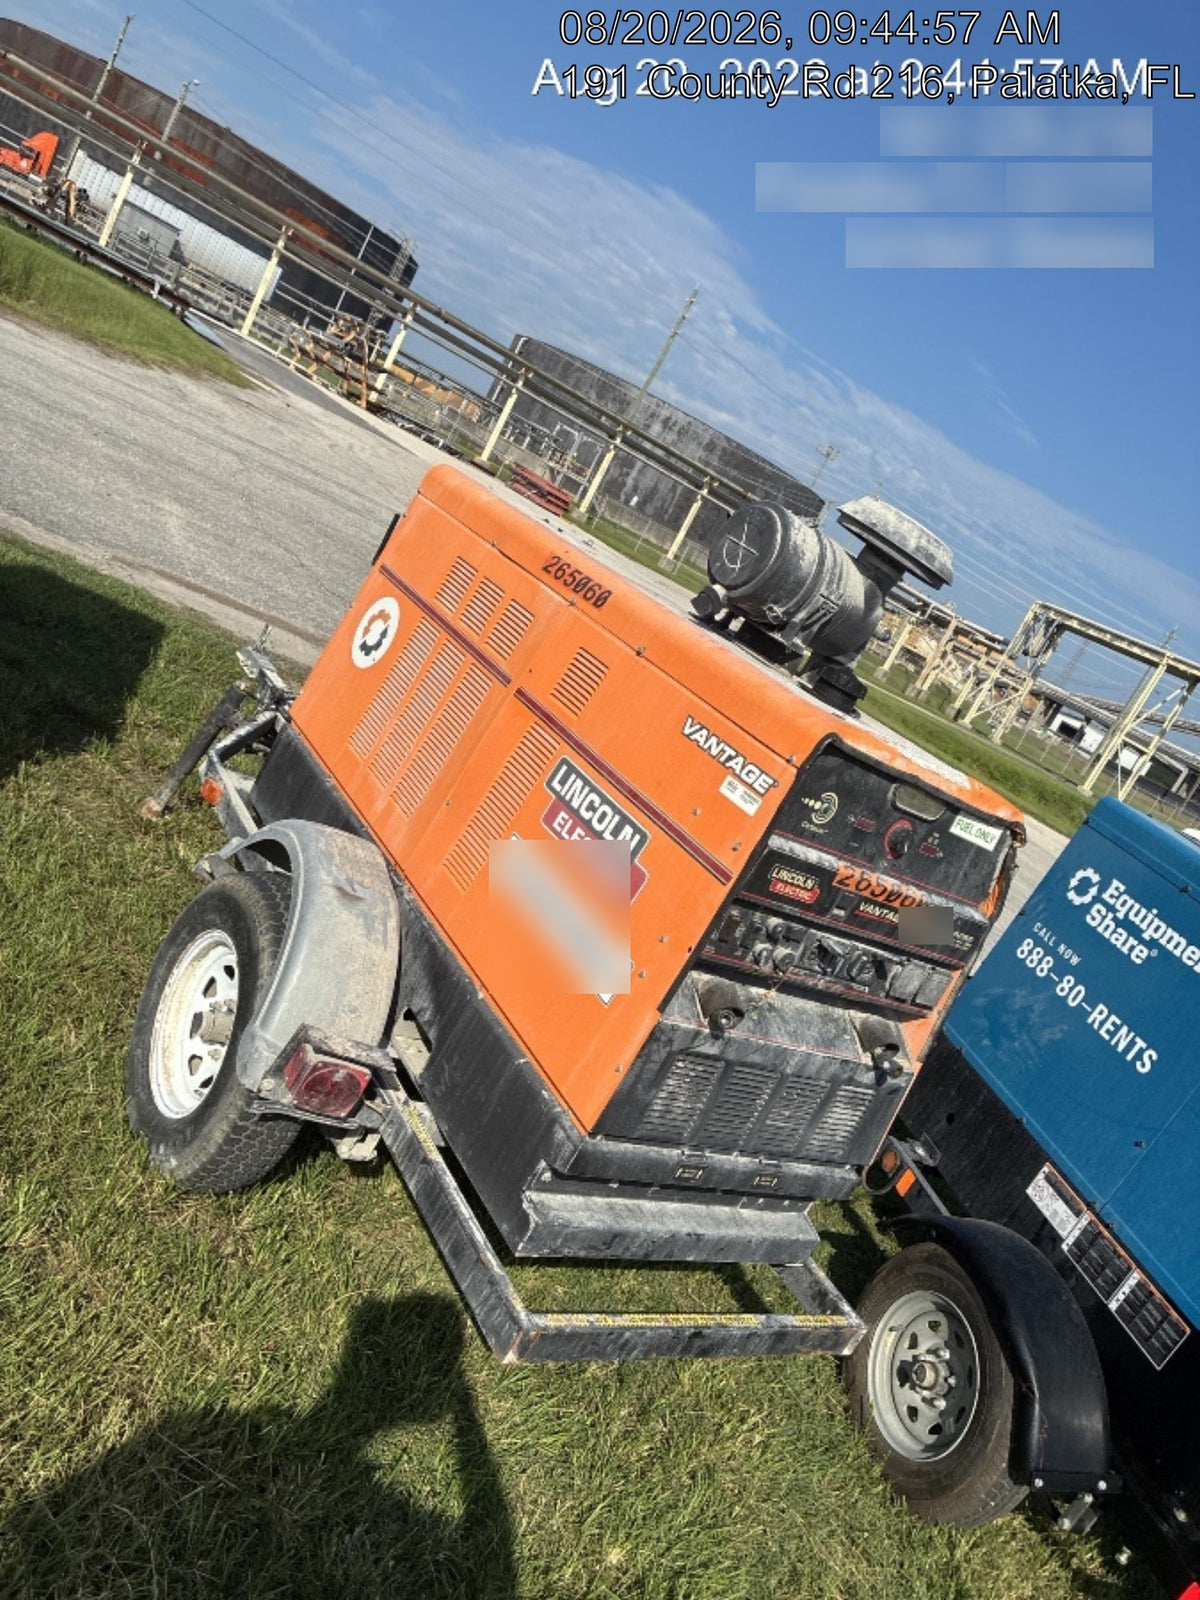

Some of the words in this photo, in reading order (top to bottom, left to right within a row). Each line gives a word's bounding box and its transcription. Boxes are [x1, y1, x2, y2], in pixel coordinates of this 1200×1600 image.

[541, 555, 613, 609] 265060
[681, 714, 776, 796] VANTAGE
[551, 764, 641, 851] LINCOLN
[834, 863, 930, 907] 26506
[1101, 877, 1200, 973] Equipme
[1032, 921, 1056, 947] CALL
[1057, 943, 1082, 966] NOW
[1016, 938, 1158, 1075] 888-80-RENTS
